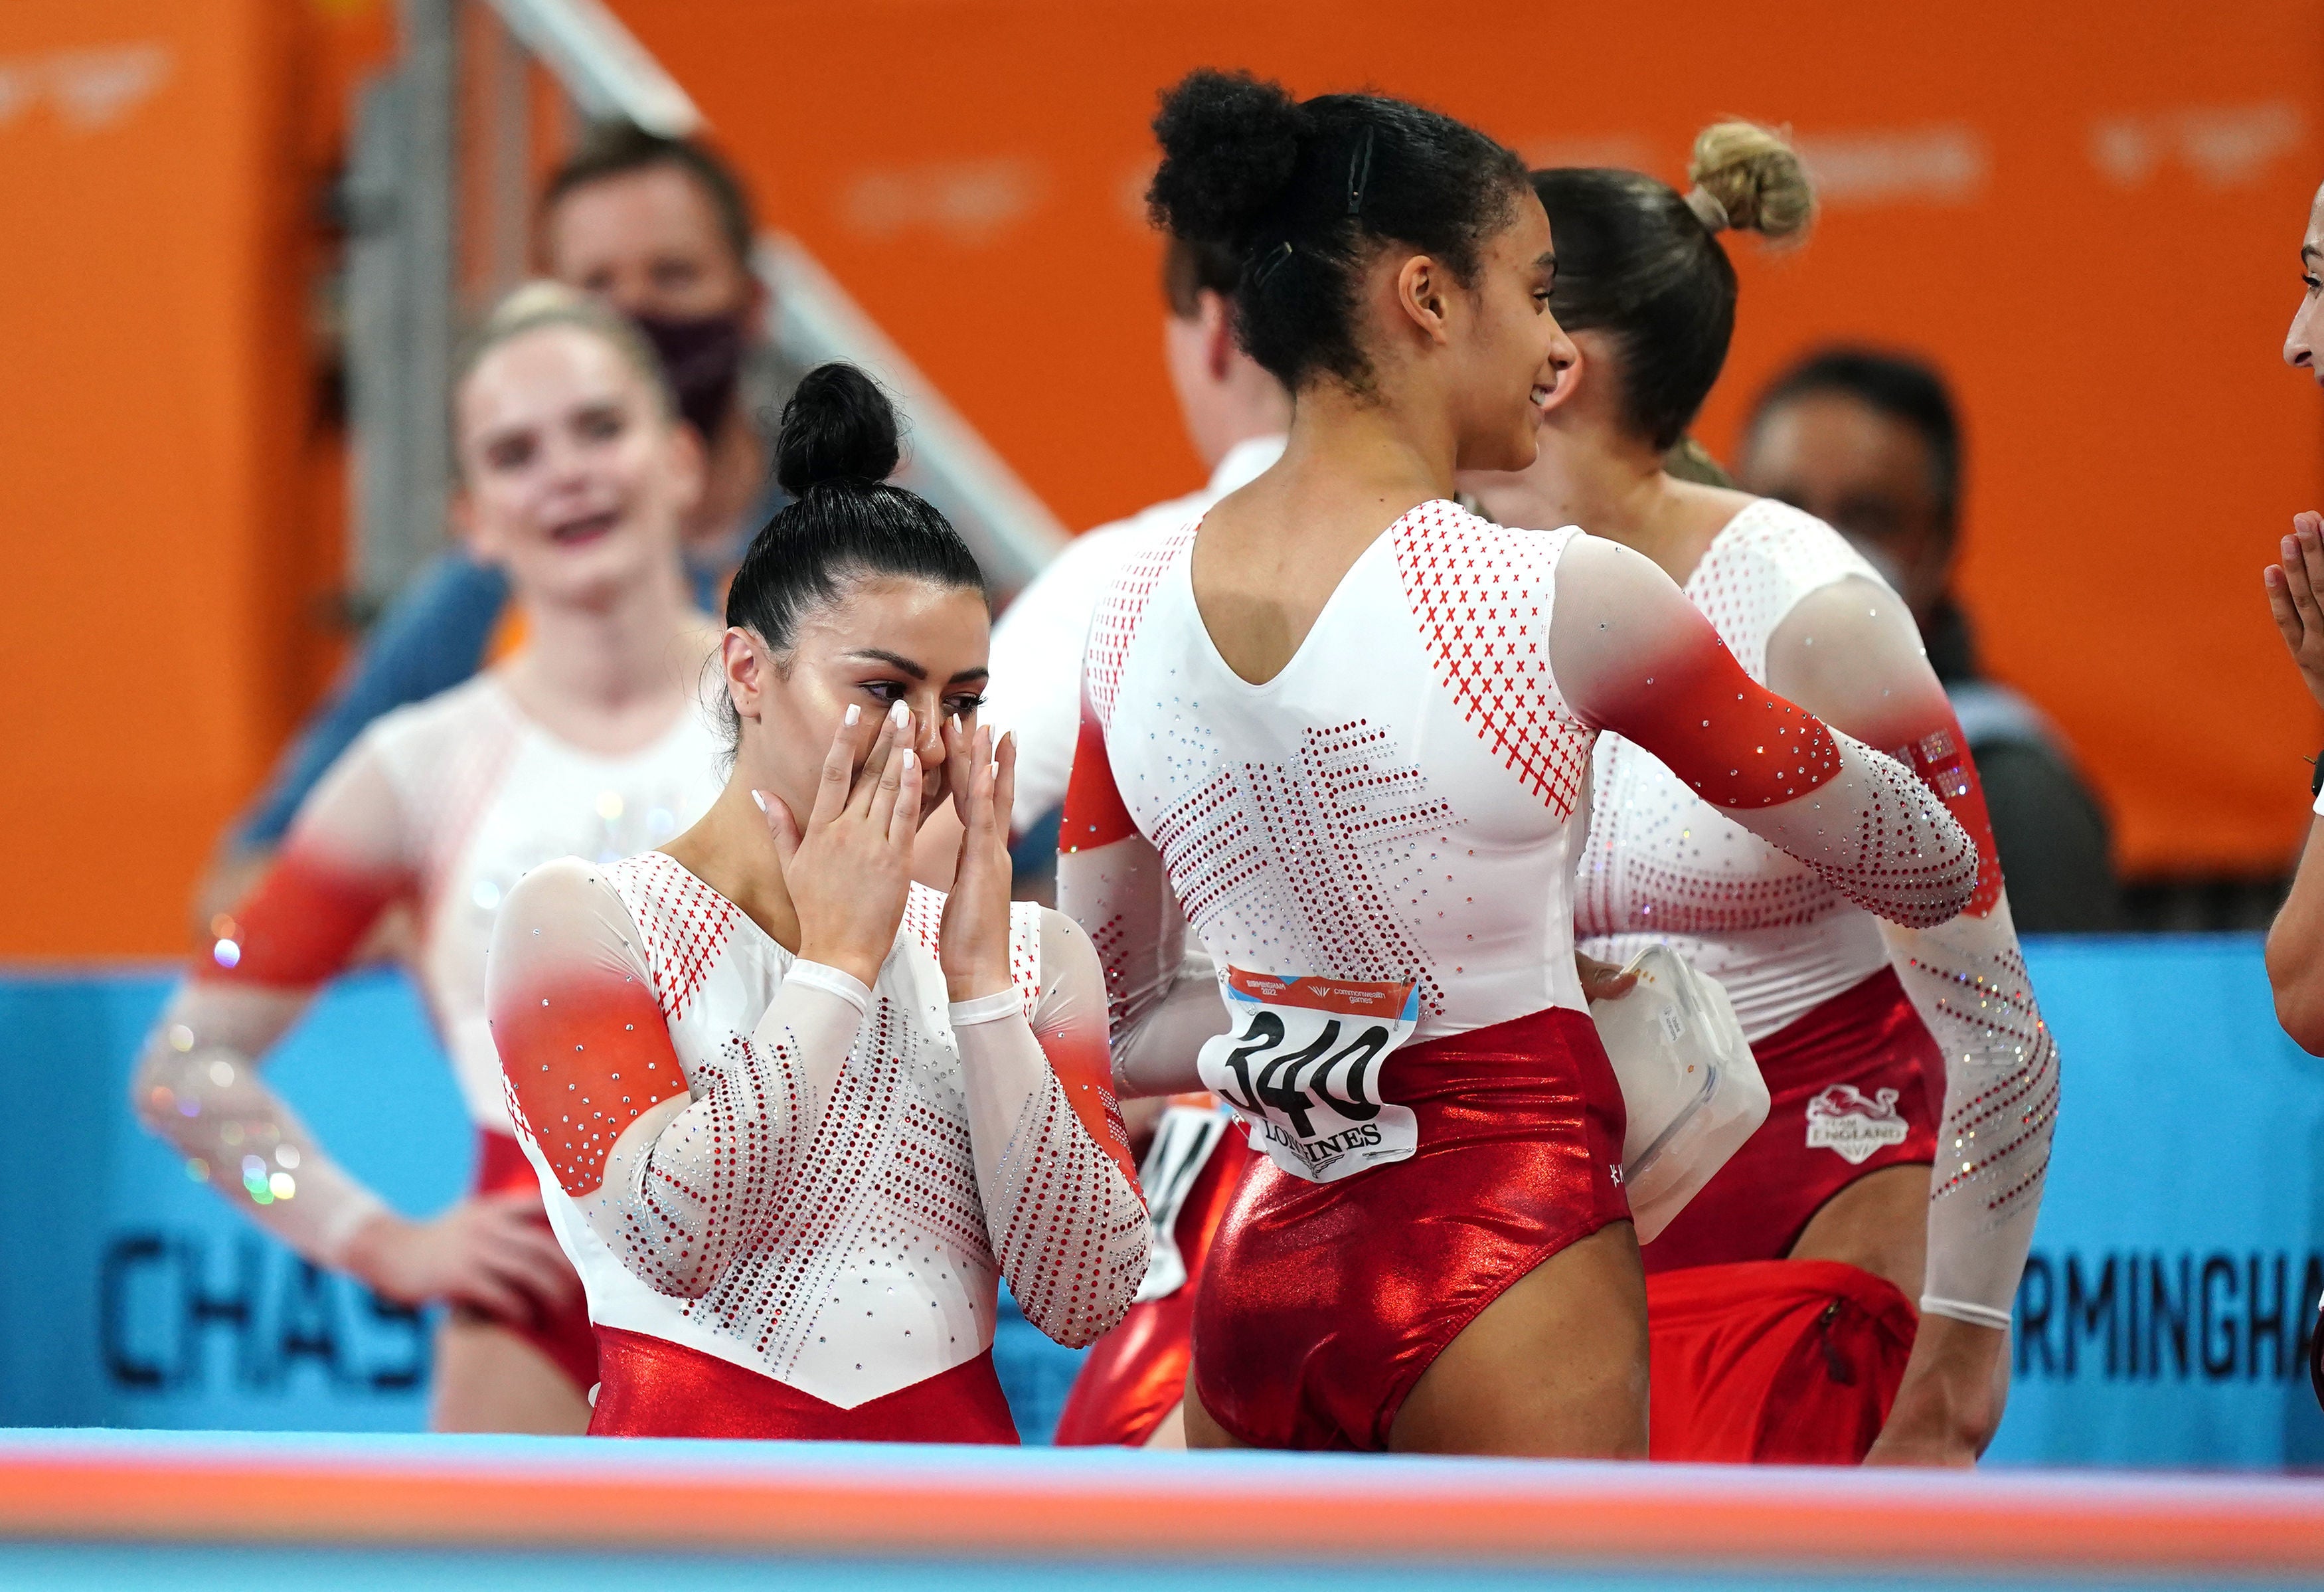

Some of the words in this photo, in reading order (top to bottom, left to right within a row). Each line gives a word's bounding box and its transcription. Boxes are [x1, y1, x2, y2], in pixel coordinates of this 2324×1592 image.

[1246, 980, 1286, 990] BIRMINGHAM
[1261, 988, 1278, 996] 2022
[1333, 988, 1386, 999] commonwealth
[1218, 1012, 1389, 1138] 340
